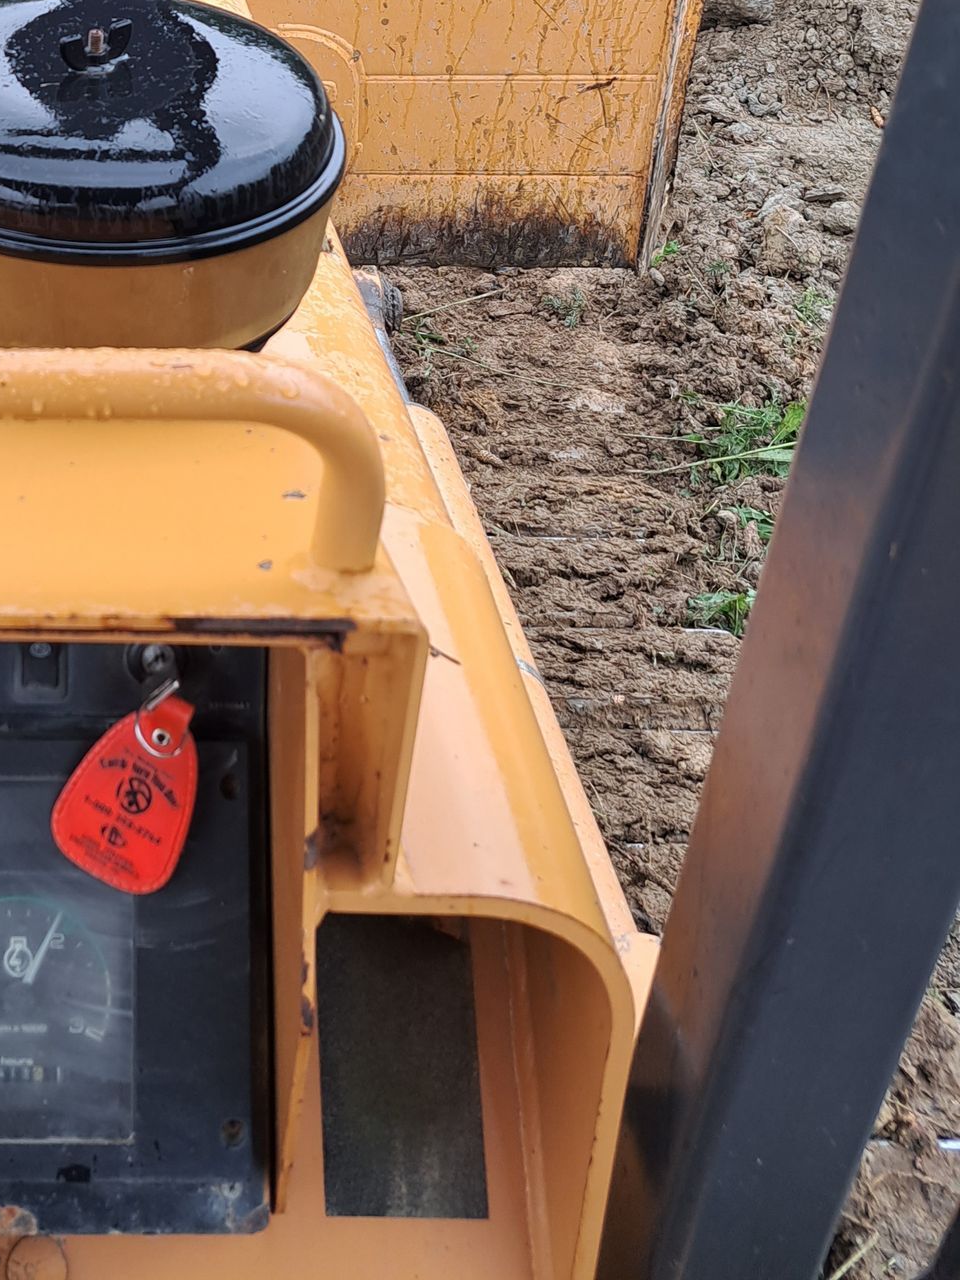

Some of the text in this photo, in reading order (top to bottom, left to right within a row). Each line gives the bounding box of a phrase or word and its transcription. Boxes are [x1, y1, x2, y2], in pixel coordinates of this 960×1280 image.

[50, 933, 65, 949] 2
[69, 1017, 84, 1033] 3
[0, 1056, 33, 1066] hours
